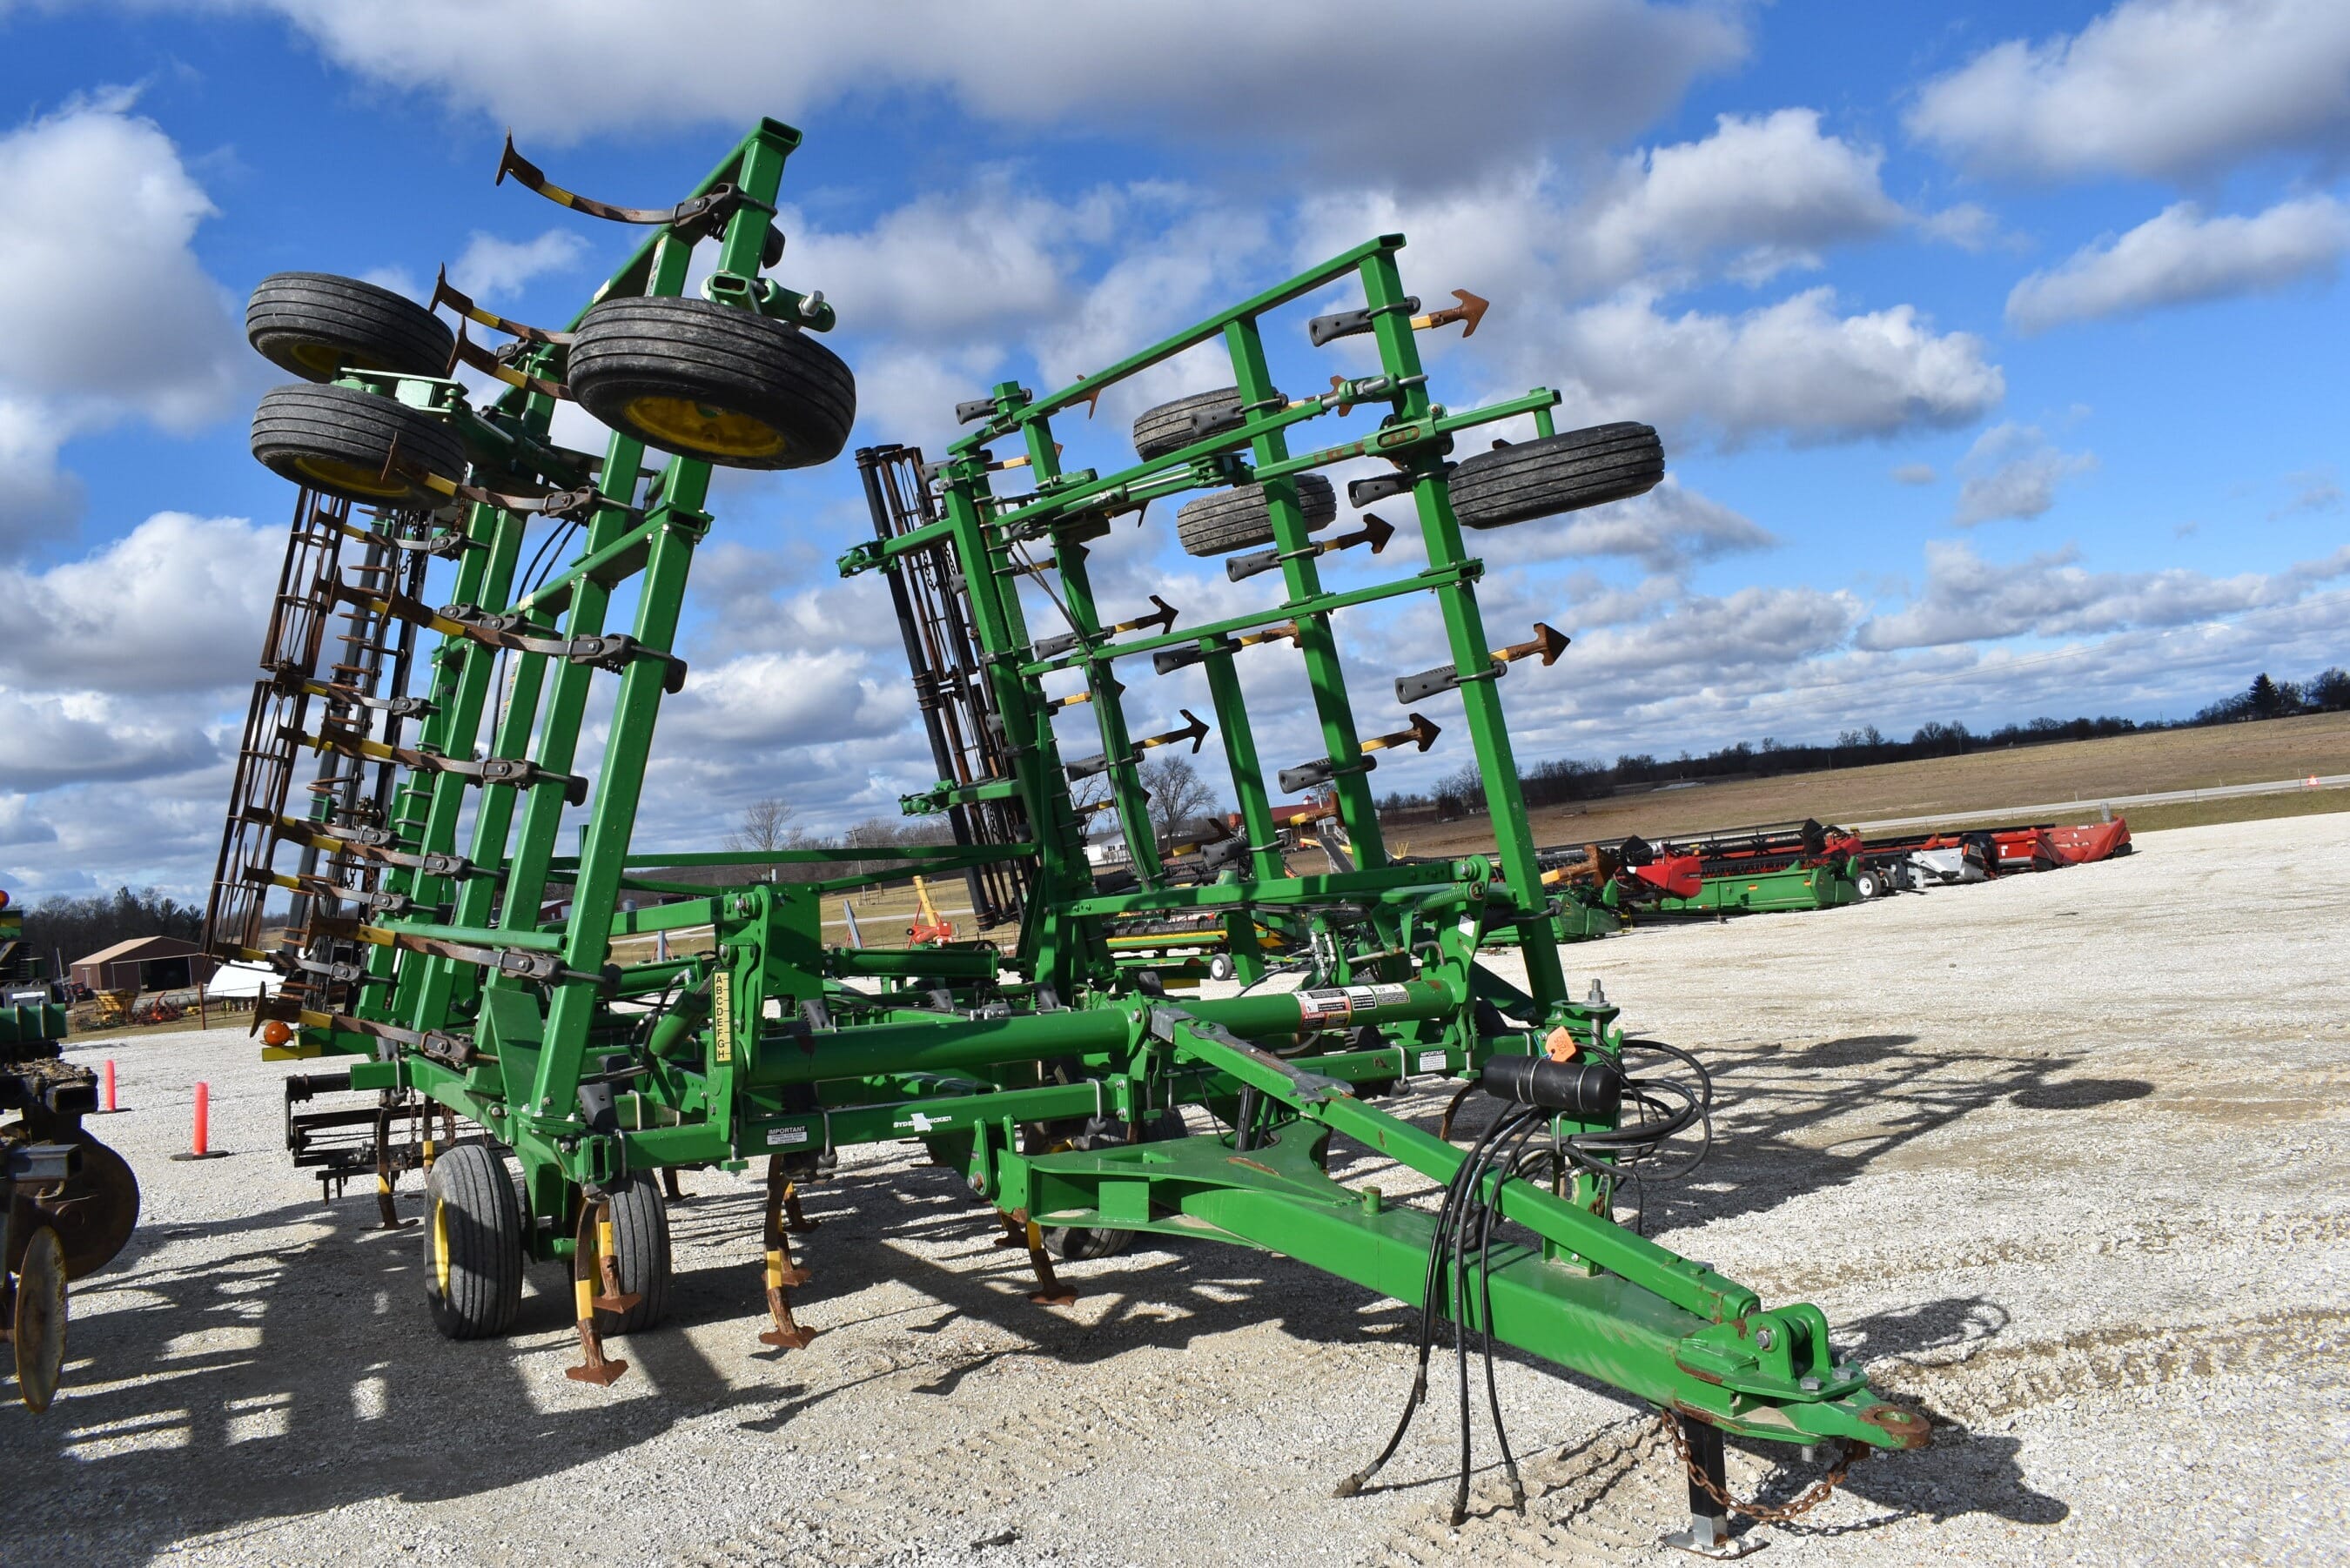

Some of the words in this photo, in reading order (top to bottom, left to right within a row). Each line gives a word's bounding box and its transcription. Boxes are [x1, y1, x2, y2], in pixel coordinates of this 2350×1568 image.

[716, 986, 722, 995] B
[716, 996, 723, 1005] C
[716, 1008, 724, 1016] D
[717, 1018, 722, 1027] E
[717, 1029, 722, 1037] F
[717, 1039, 725, 1048] G
[768, 1126, 806, 1136] IMPORTANT
